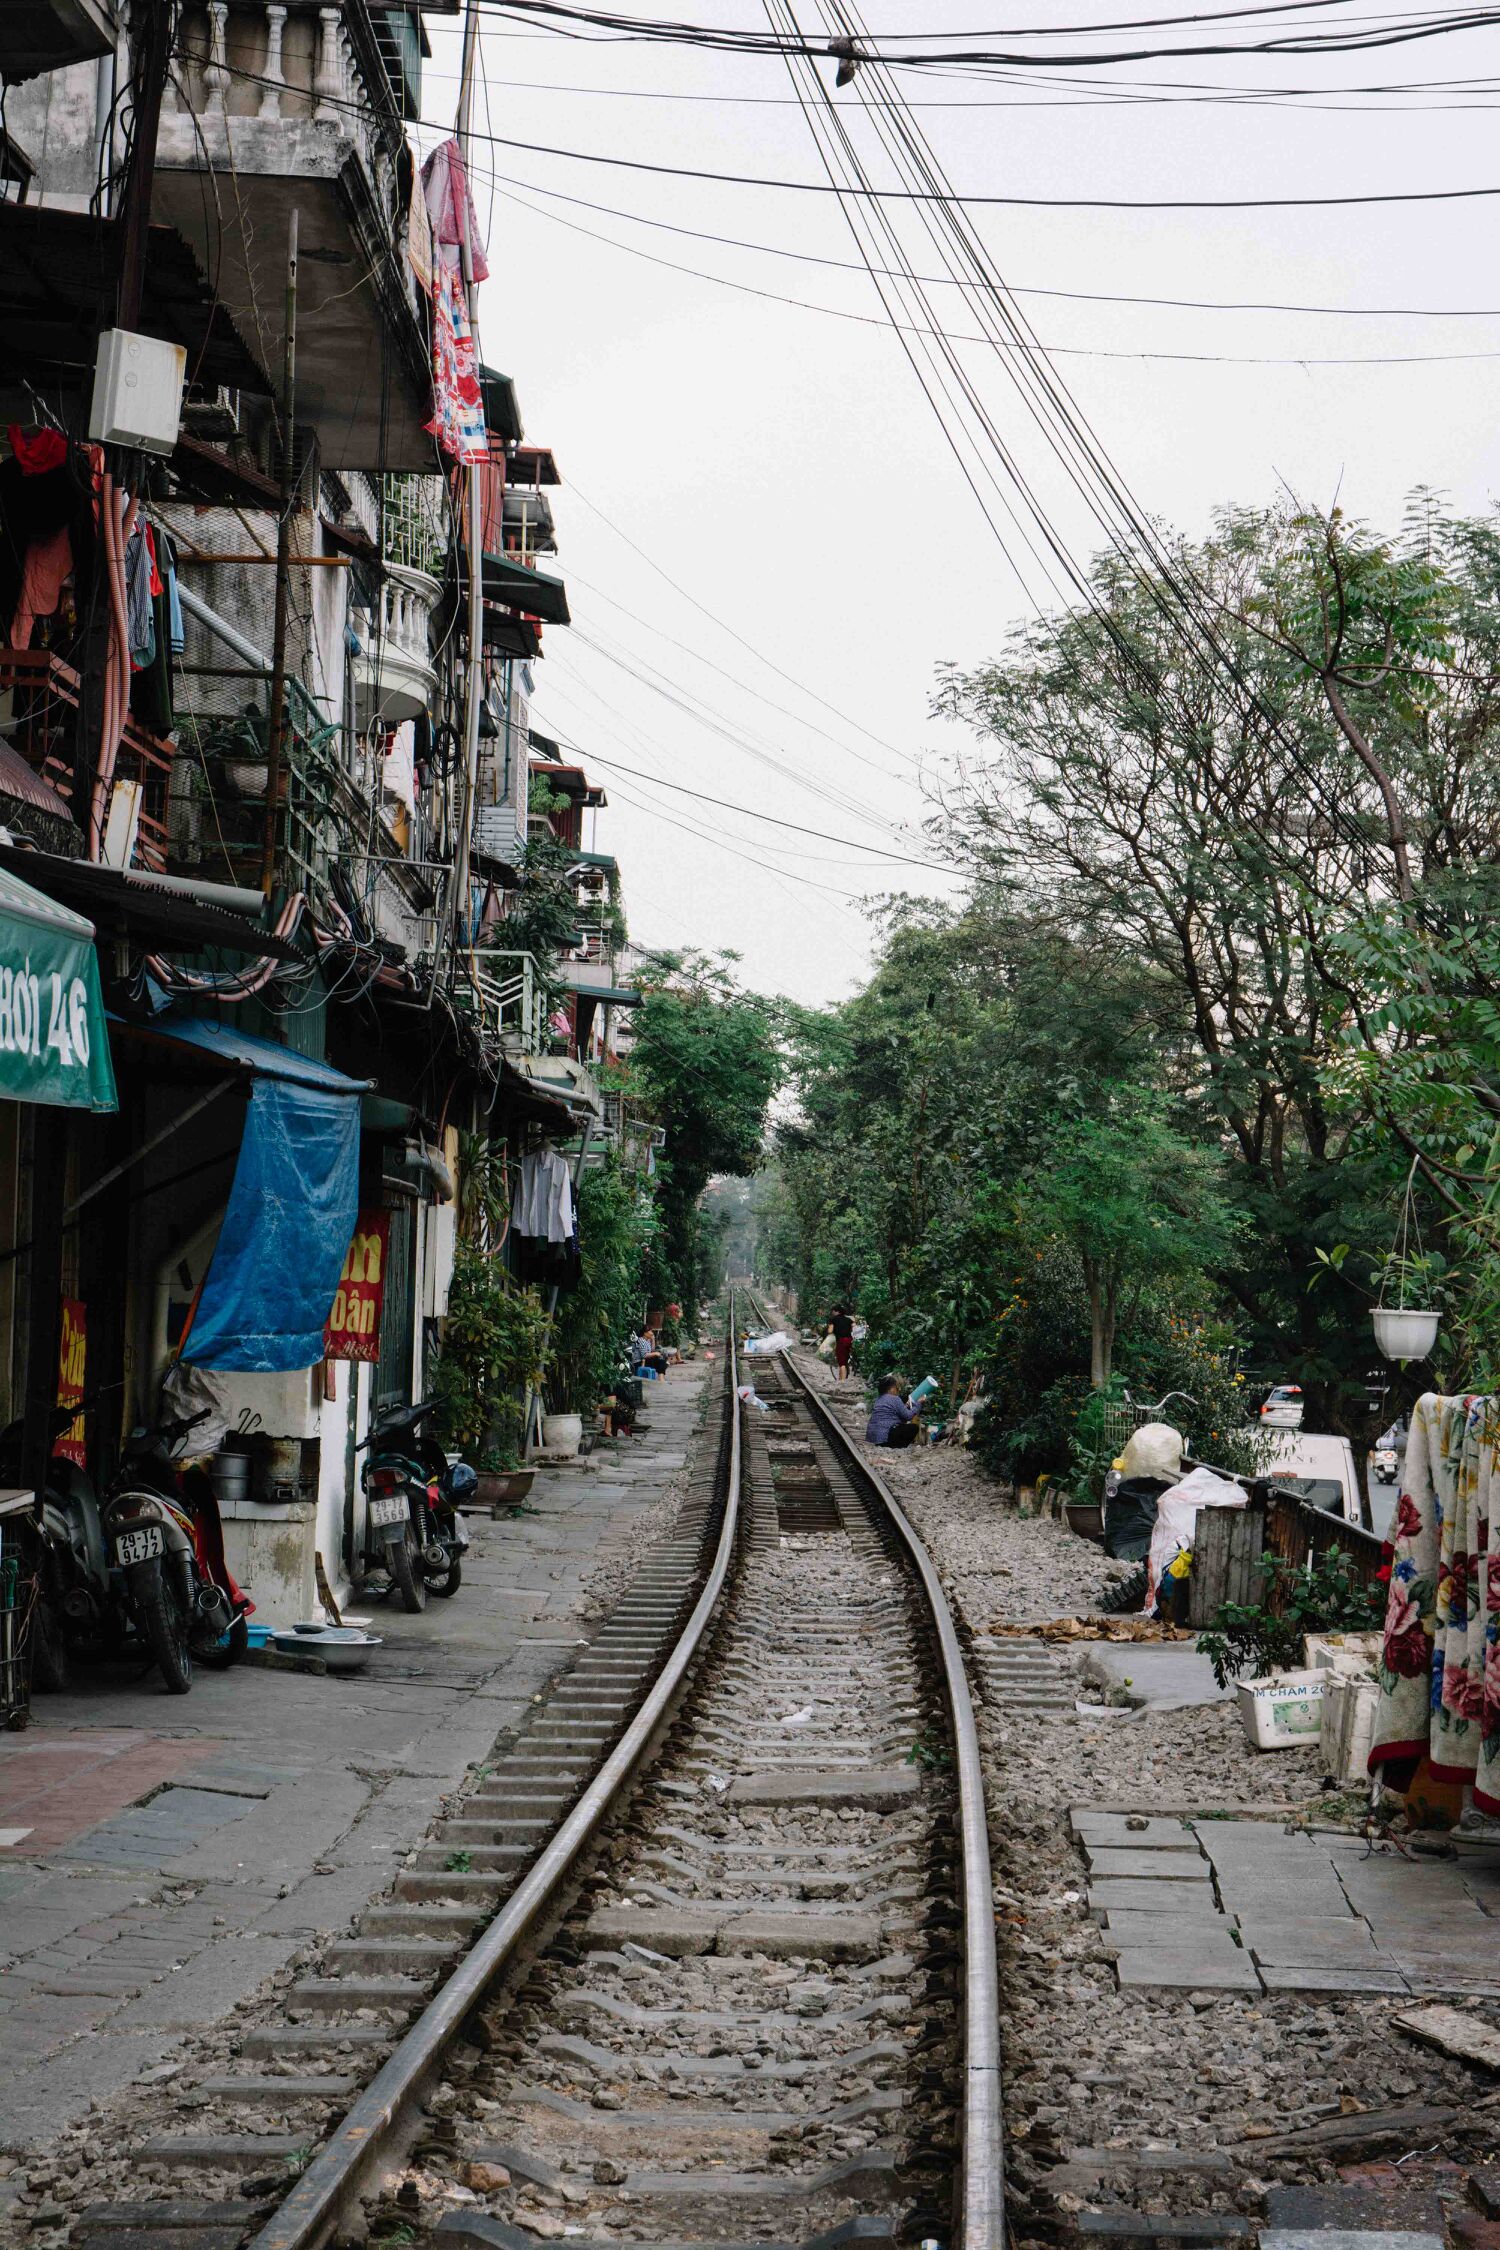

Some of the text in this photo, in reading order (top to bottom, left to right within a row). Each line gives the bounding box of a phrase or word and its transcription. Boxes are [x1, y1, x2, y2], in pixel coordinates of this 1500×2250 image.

[48, 972, 90, 1068] 46
[330, 1289, 375, 1334] Dân
[120, 1528, 157, 1550] 29-T4
[123, 1542, 159, 1563] 9472
[1270, 1687, 1307, 1697] CHAM
